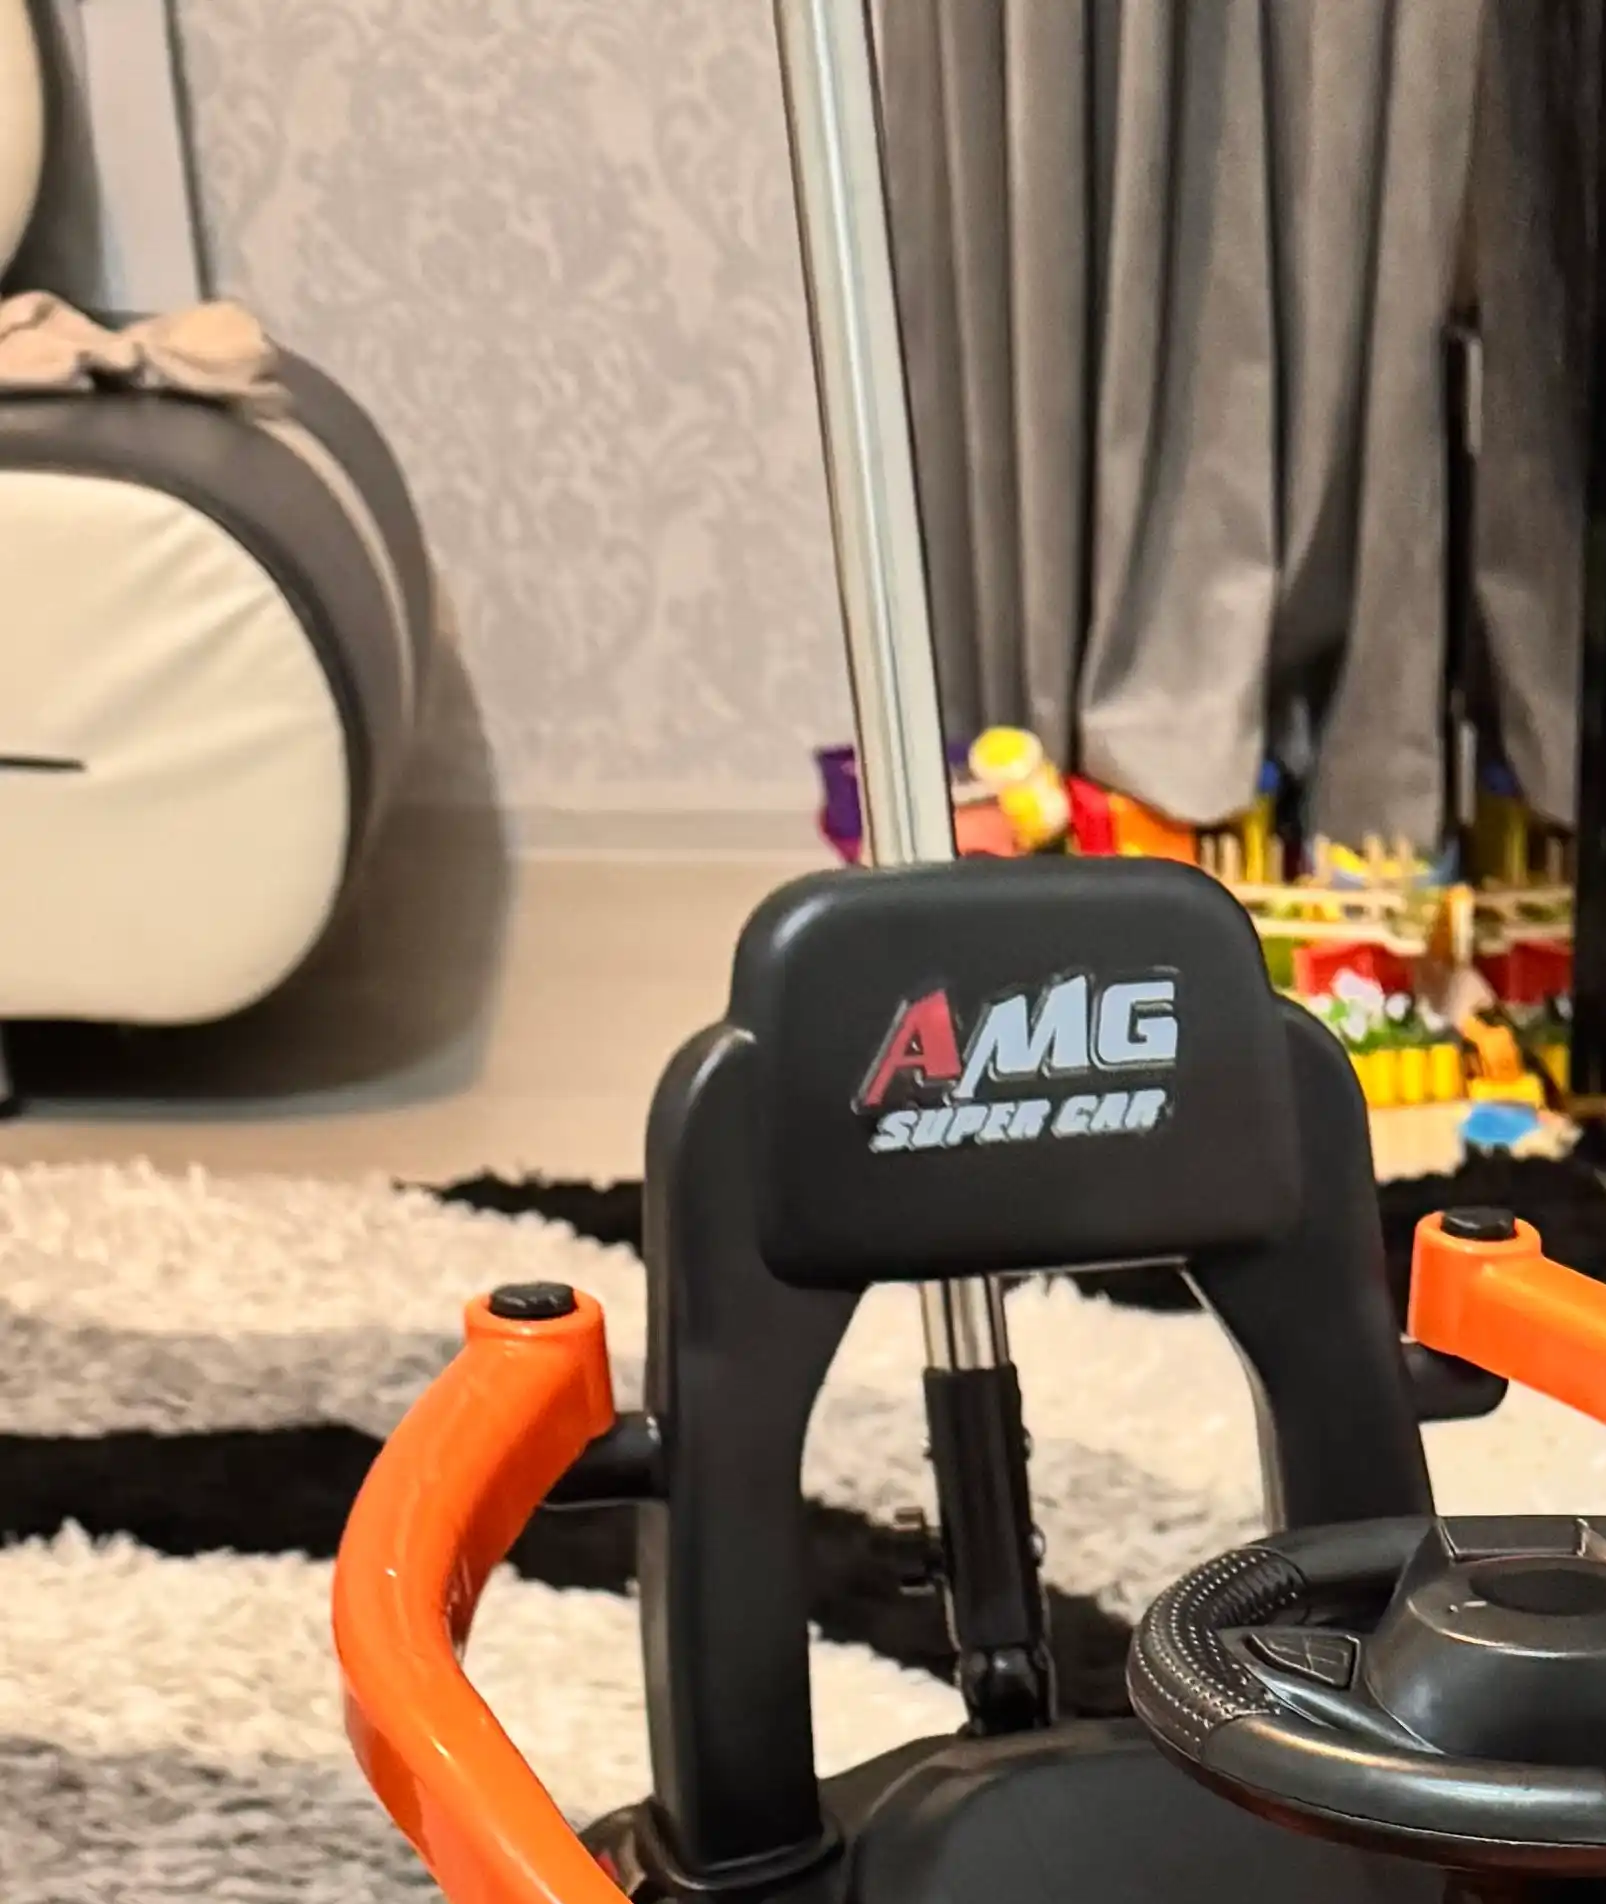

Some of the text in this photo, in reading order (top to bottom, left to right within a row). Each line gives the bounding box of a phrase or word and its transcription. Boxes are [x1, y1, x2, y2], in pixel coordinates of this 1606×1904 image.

[856, 973, 1179, 1107] AMG
[871, 1089, 1166, 1152] SUPER CAR
